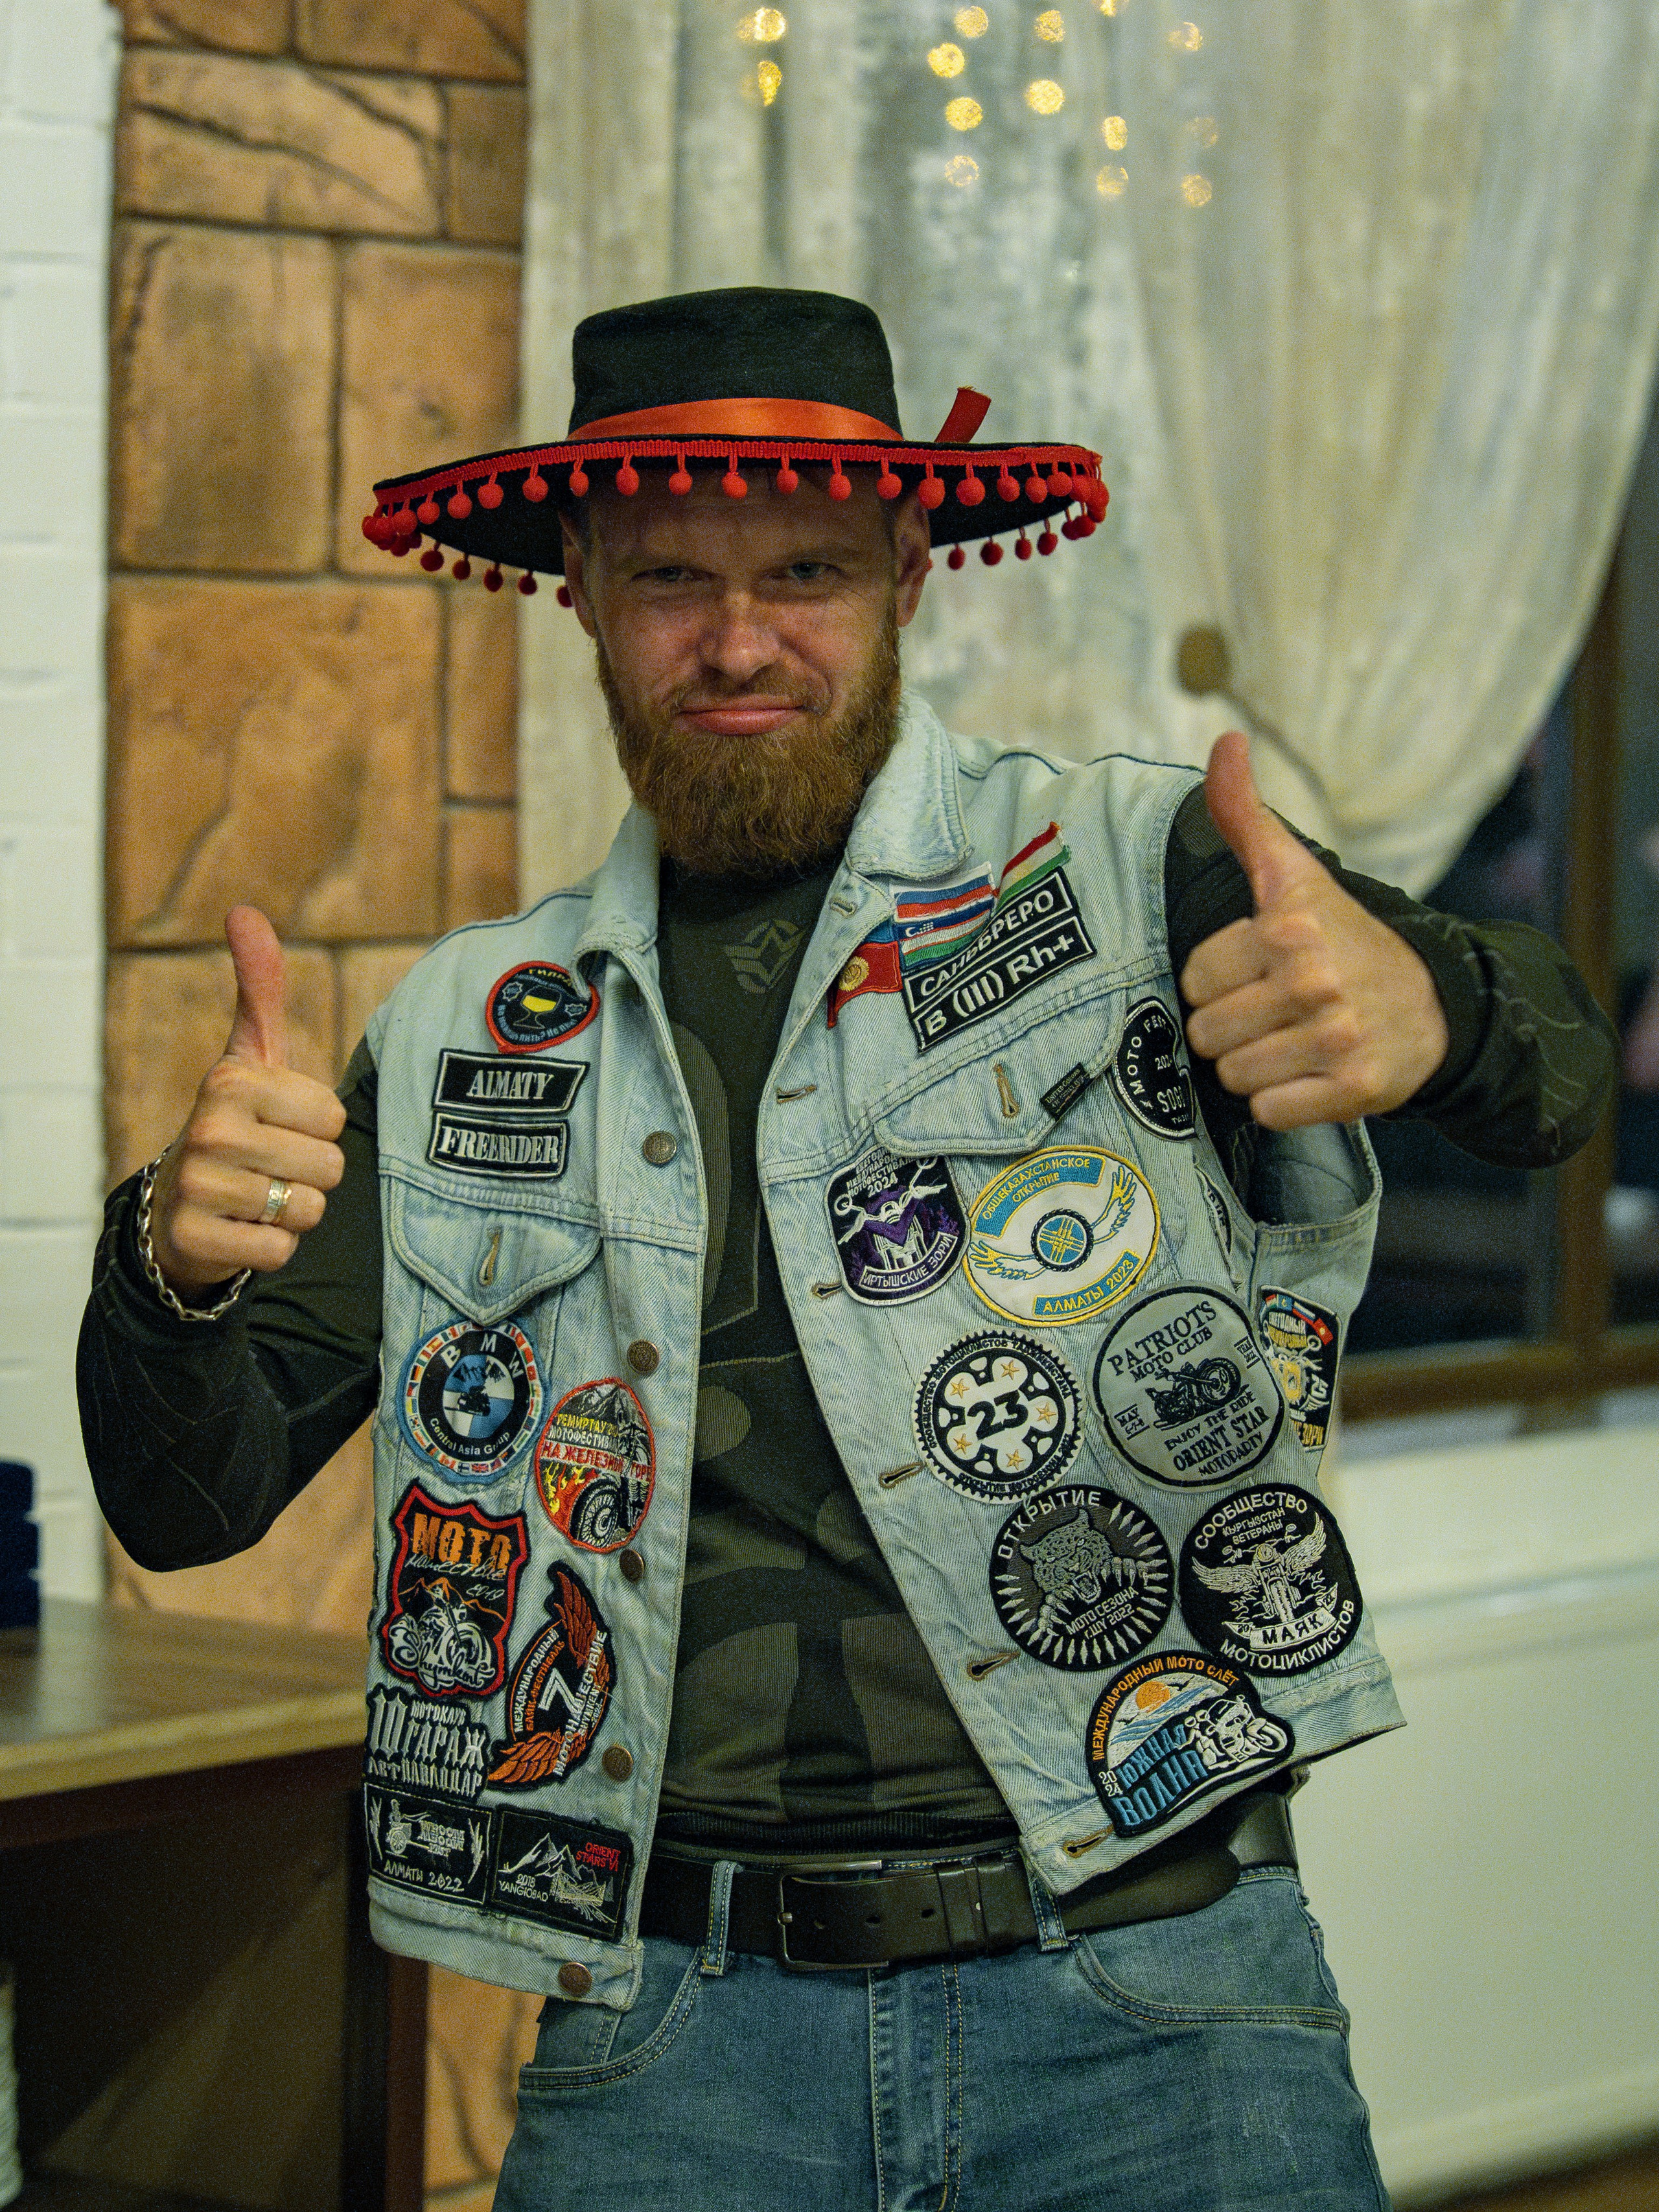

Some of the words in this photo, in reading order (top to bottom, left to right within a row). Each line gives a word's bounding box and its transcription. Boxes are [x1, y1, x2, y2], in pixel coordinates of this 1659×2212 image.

[1006, 934, 1074, 985] Rh+
[467, 1069, 554, 1100] ALMATY
[1127, 1036, 1145, 1095] MOTO
[437, 1126, 559, 1164] FREERIDER
[868, 1172, 898, 1198] 2024
[982, 1158, 1090, 1220] ОБЩЕКАЗАХСТАНСКОЕ
[1012, 1173, 1060, 1203] ОТКРЫТИЕ
[863, 1264, 929, 1287] ИРТЫШСКИЕ
[929, 1237, 952, 1268] ЗОРИ
[1043, 1286, 1104, 1313] АЛМАТЫ
[1106, 1260, 1134, 1290] 2023
[441, 1333, 524, 1379] BMW
[1107, 1300, 1216, 1376] PATRIOTS
[1130, 1353, 1174, 1382] MOTO
[1176, 1327, 1212, 1355] CLUB
[430, 1417, 457, 1451] Central
[458, 1446, 481, 1455] Asia
[483, 1431, 511, 1454] Group
[967, 1390, 1028, 1440] 23
[1164, 1425, 1201, 1451] ENJOY
[1203, 1408, 1228, 1426] THE
[1229, 1392, 1257, 1415] RIDE
[1173, 1425, 1231, 1471] ORIENT
[1231, 1405, 1270, 1438] STAR
[542, 1441, 561, 1458] НА
[412, 1513, 511, 1577] МОТО
[998, 1489, 1102, 1559] ОТКРЫТИЕ
[1195, 1491, 1308, 1550] СООБЩЕСТВО
[1222, 1507, 1286, 1538] КЫРГЫЗСТАН
[1232, 1520, 1283, 1545] ВЕТЕРАНЫ
[1066, 1611, 1096, 1636] МОТО
[1096, 1587, 1139, 1616] СЕЗОНА
[1111, 1603, 1135, 1626] 2022
[1220, 1600, 1355, 1670] МОТОЦИКЛИСТОВ
[1263, 1613, 1323, 1646] МАЯК
[1093, 1659, 1164, 1762] МЕЖДУНАРОДНЫЙ
[1166, 1655, 1205, 1670] МОТО
[1207, 1664, 1240, 1687] СЛЁТ
[1115, 1724, 1187, 1789] ЮЖНАЯ
[1111, 1750, 1209, 1826] ВОЛНА
[384, 1859, 423, 1881] АЛМАТЫ
[428, 1872, 464, 1892] 2022
[576, 1851, 606, 1868] STARS
[585, 1842, 621, 1860] ORIENT
[516, 1874, 535, 1888] 2018
